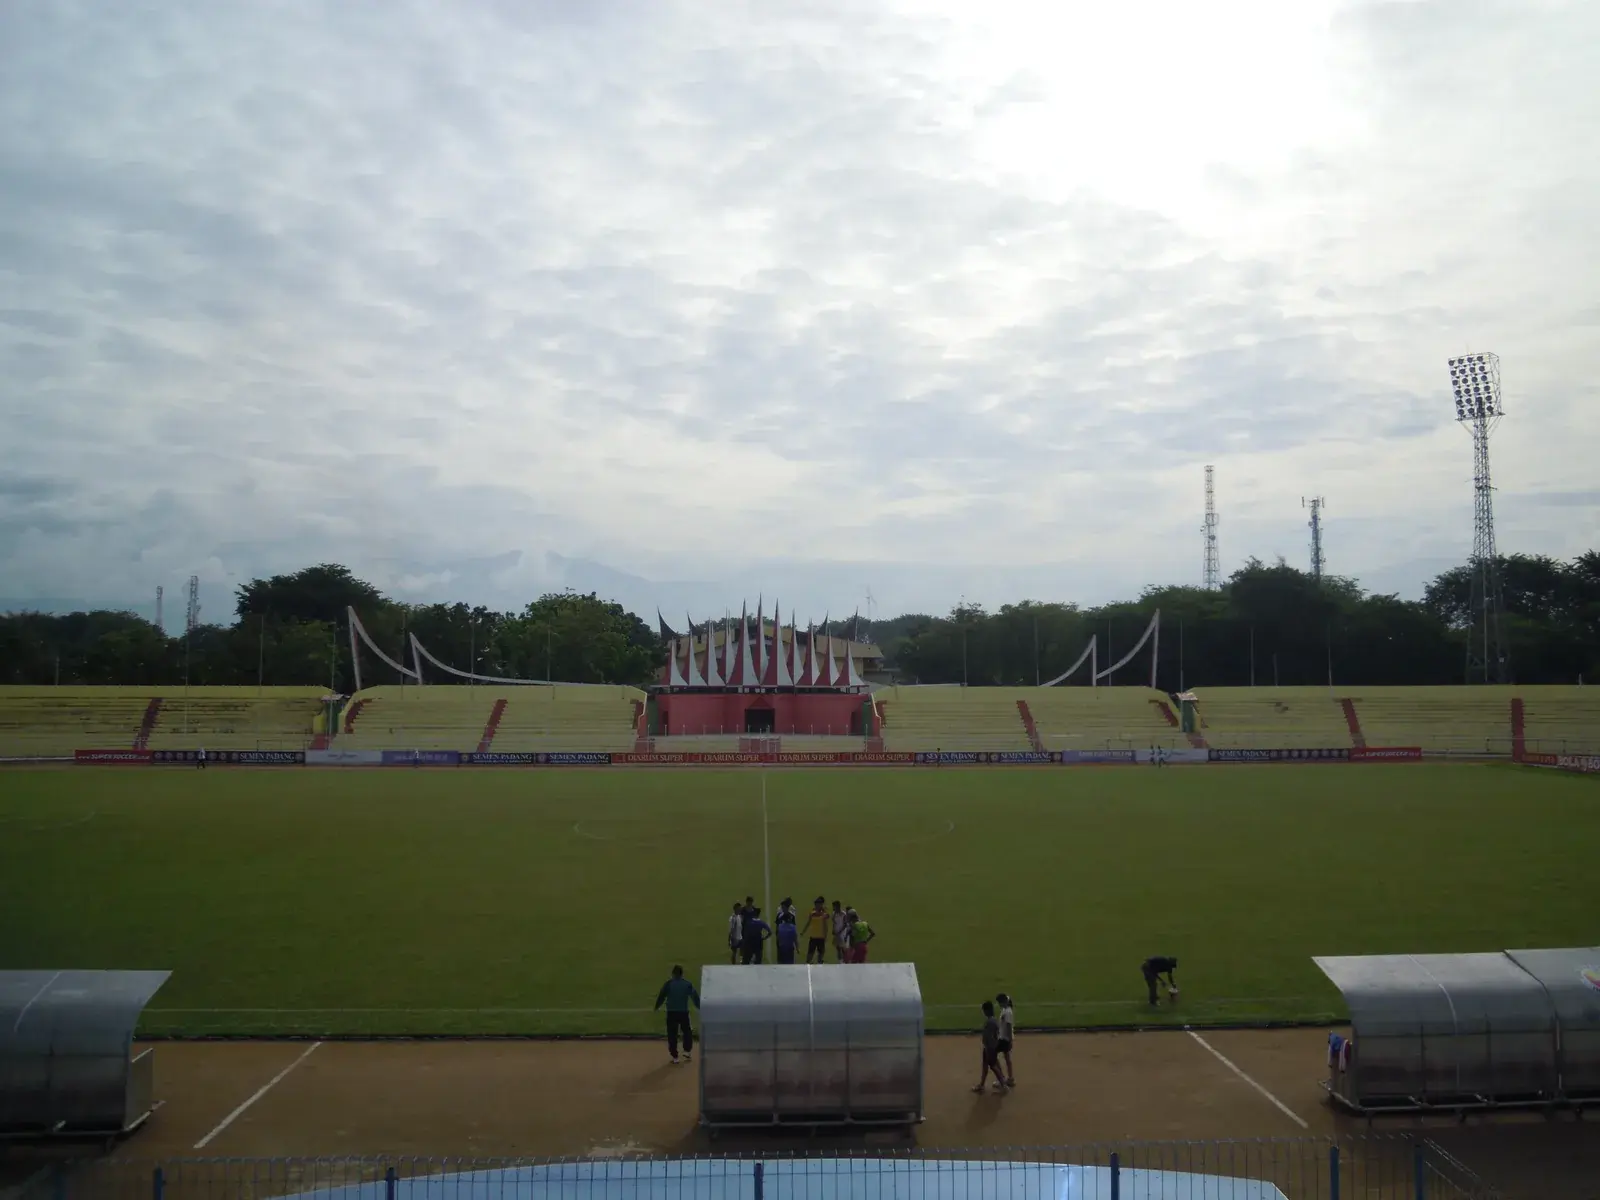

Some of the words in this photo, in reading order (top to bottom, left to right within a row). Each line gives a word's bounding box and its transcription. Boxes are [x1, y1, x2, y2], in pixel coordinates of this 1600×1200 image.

[240, 752, 264, 760] SEMEN
[266, 752, 295, 760] PADANG
[473, 753, 500, 761] SEMEN
[501, 753, 532, 761] PADANG
[549, 753, 576, 761] SEMEN
[577, 753, 609, 761] PADANG
[950, 752, 977, 760] PADANG
[1000, 752, 1025, 760] SEMEN
[1025, 752, 1051, 760] PADANG
[1218, 749, 1242, 757] SEMEN
[1242, 749, 1269, 757] PADANG
[659, 754, 683, 763] SUPER
[736, 754, 759, 763] SUPER
[811, 754, 835, 763] SUPER
[886, 753, 910, 762] SUPER
[1557, 755, 1580, 767] BOLA
